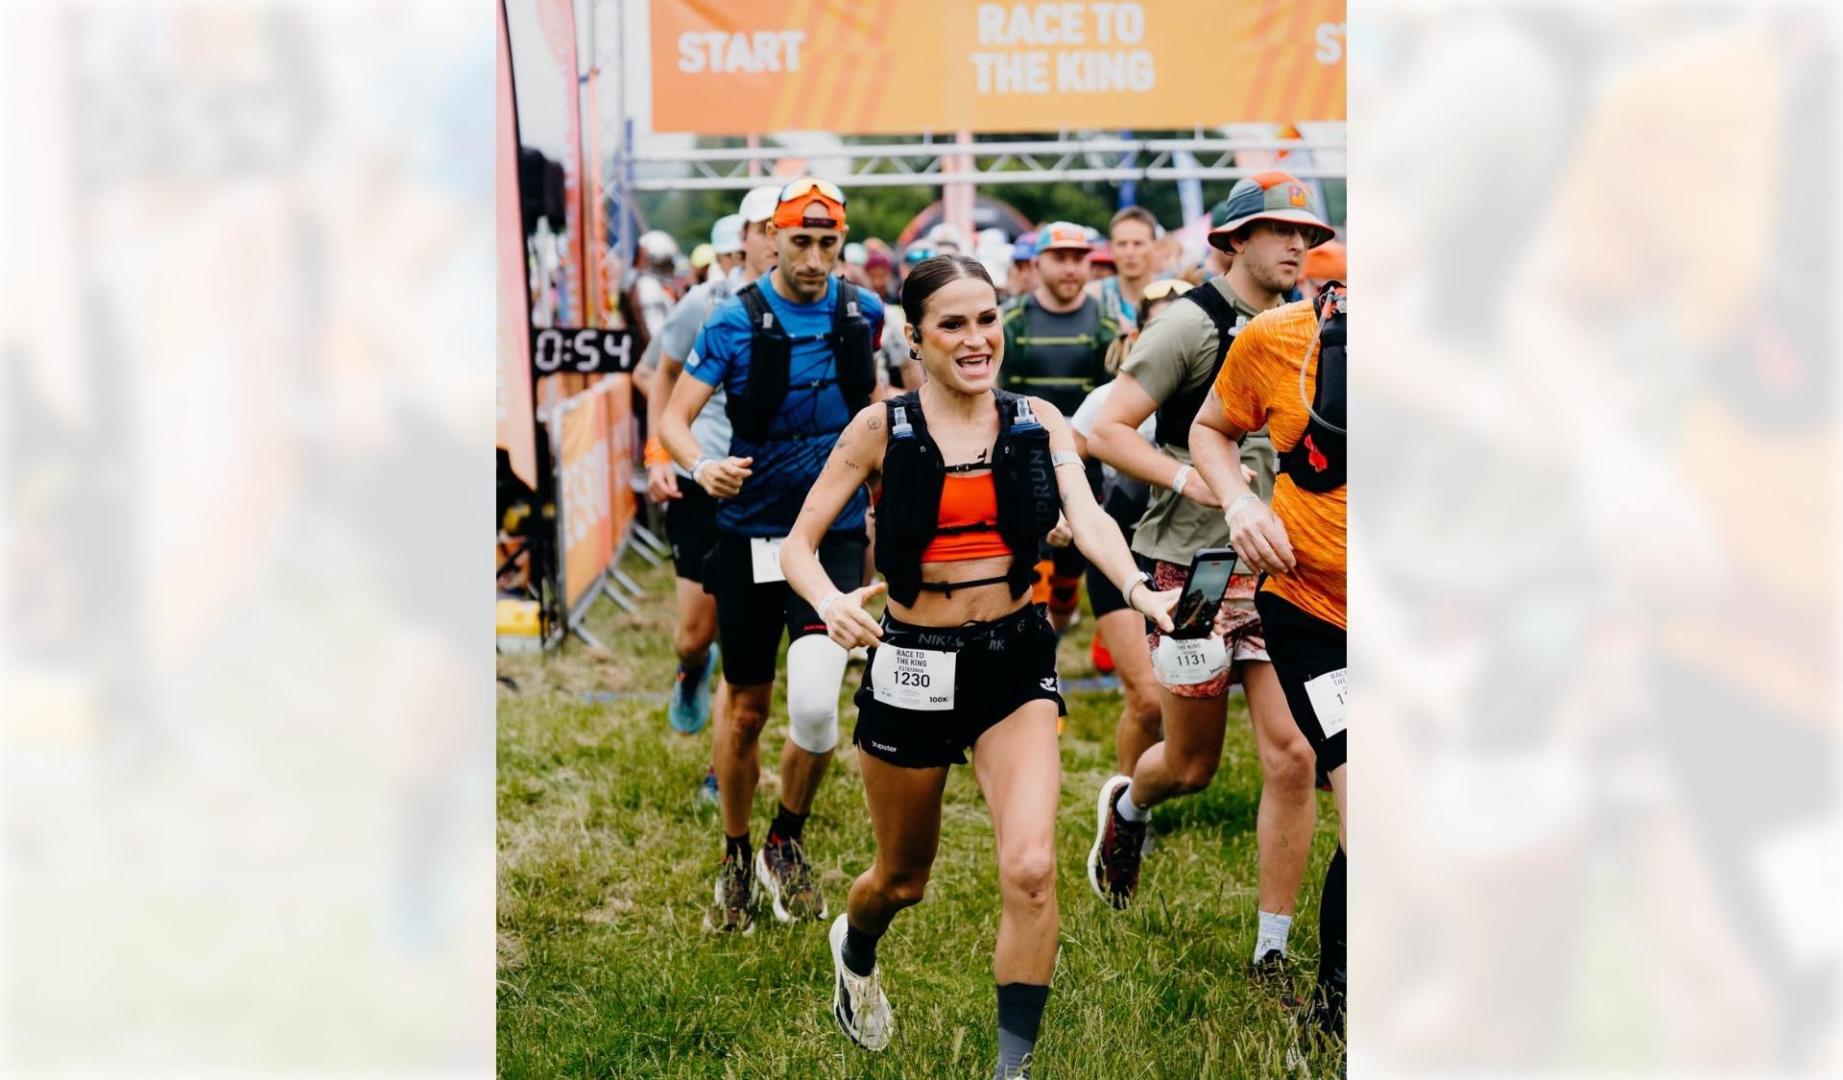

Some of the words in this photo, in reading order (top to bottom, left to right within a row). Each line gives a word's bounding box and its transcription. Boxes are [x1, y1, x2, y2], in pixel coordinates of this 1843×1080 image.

[977, 3, 1088, 45] RACE
[1090, 3, 1144, 44] TO
[677, 31, 804, 74] START
[1315, 22, 1347, 65] S
[971, 51, 1051, 94] THE
[1057, 51, 1155, 92] KING
[896, 649, 914, 658] RACE
[915, 651, 925, 659] TO
[897, 657, 909, 665] THE
[910, 659, 927, 667] KING
[1177, 653, 1206, 666] 1131
[893, 671, 931, 688] 1230
